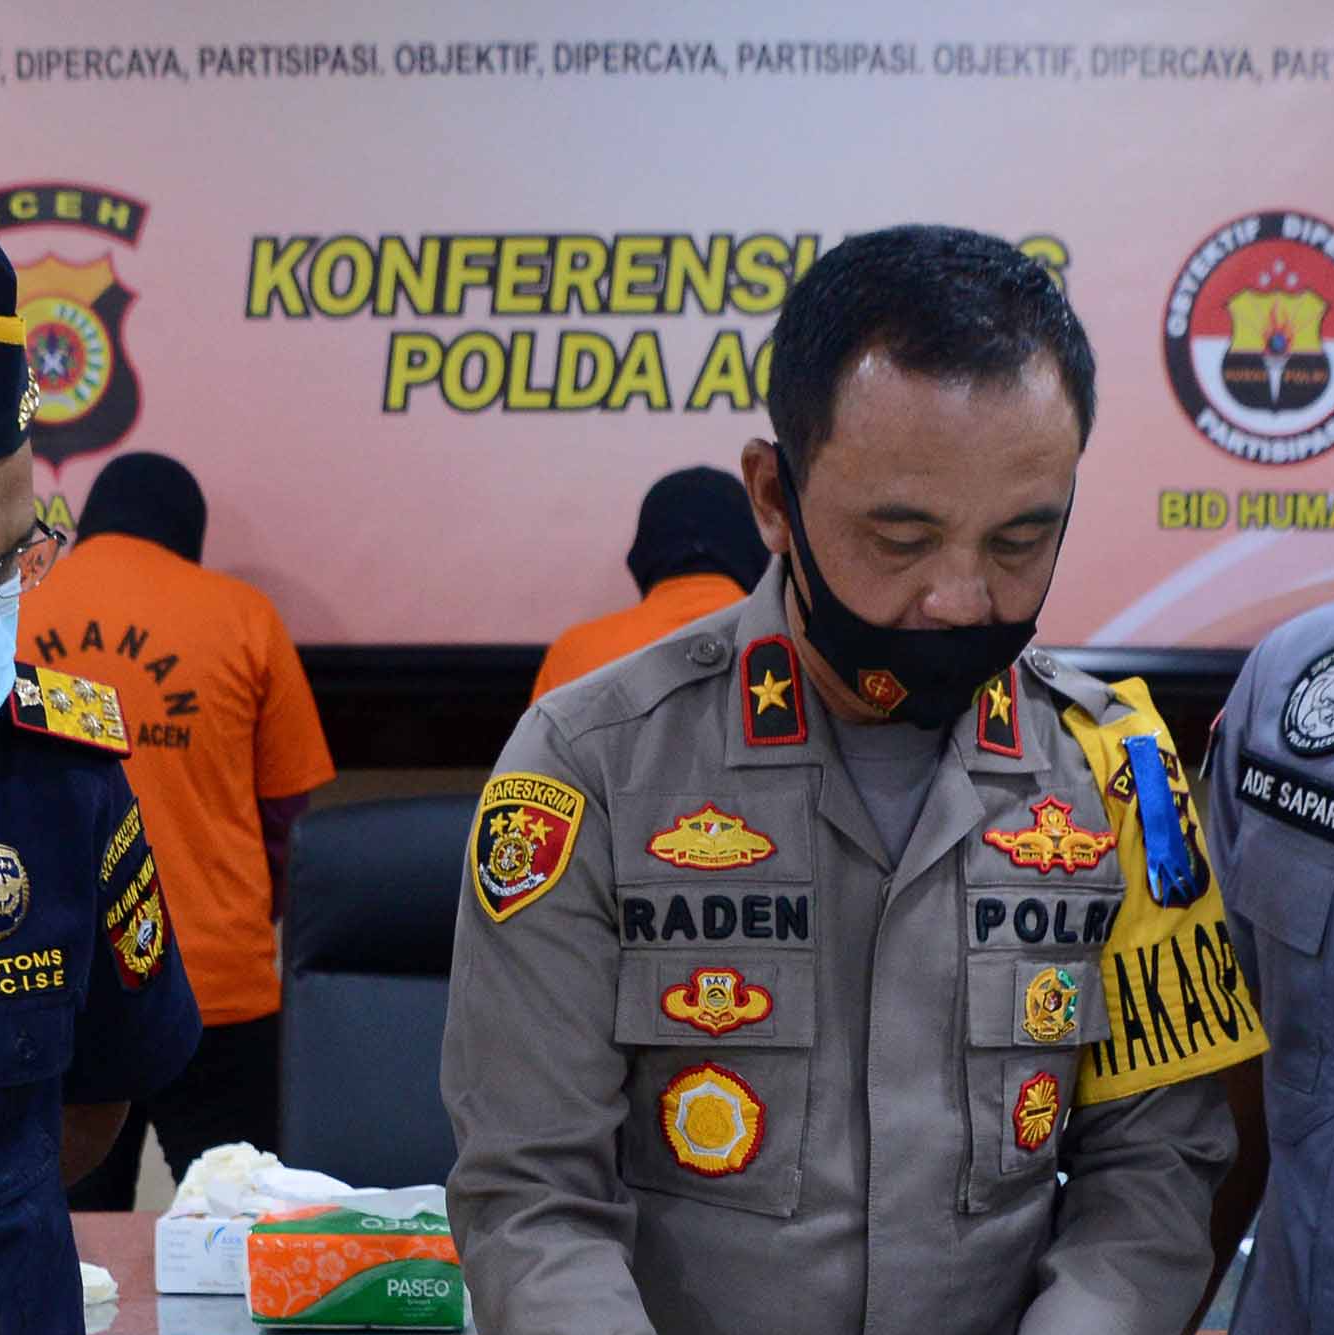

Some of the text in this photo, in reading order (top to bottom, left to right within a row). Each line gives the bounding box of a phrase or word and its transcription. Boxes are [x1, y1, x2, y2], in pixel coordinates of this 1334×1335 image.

[15, 46, 189, 83] DIPERCAYA,
[198, 43, 385, 76] PARTISIPASI.
[394, 42, 546, 79] OBJEKTIF,
[553, 41, 728, 81] DIPERCAYA,
[738, 43, 923, 76] PARTISIPASI.
[933, 45, 1081, 82] OBJEKTIF,
[1092, 45, 1263, 85] DIPERCAYA,
[383, 330, 669, 413] POLDA
[1158, 489, 1228, 530] BID
[138, 723, 191, 749] ACEH
[487, 780, 576, 816] BARESKRIM
[1242, 767, 1276, 800] ADE
[623, 895, 809, 941] RADEN
[386, 1278, 451, 1297] PASEO
